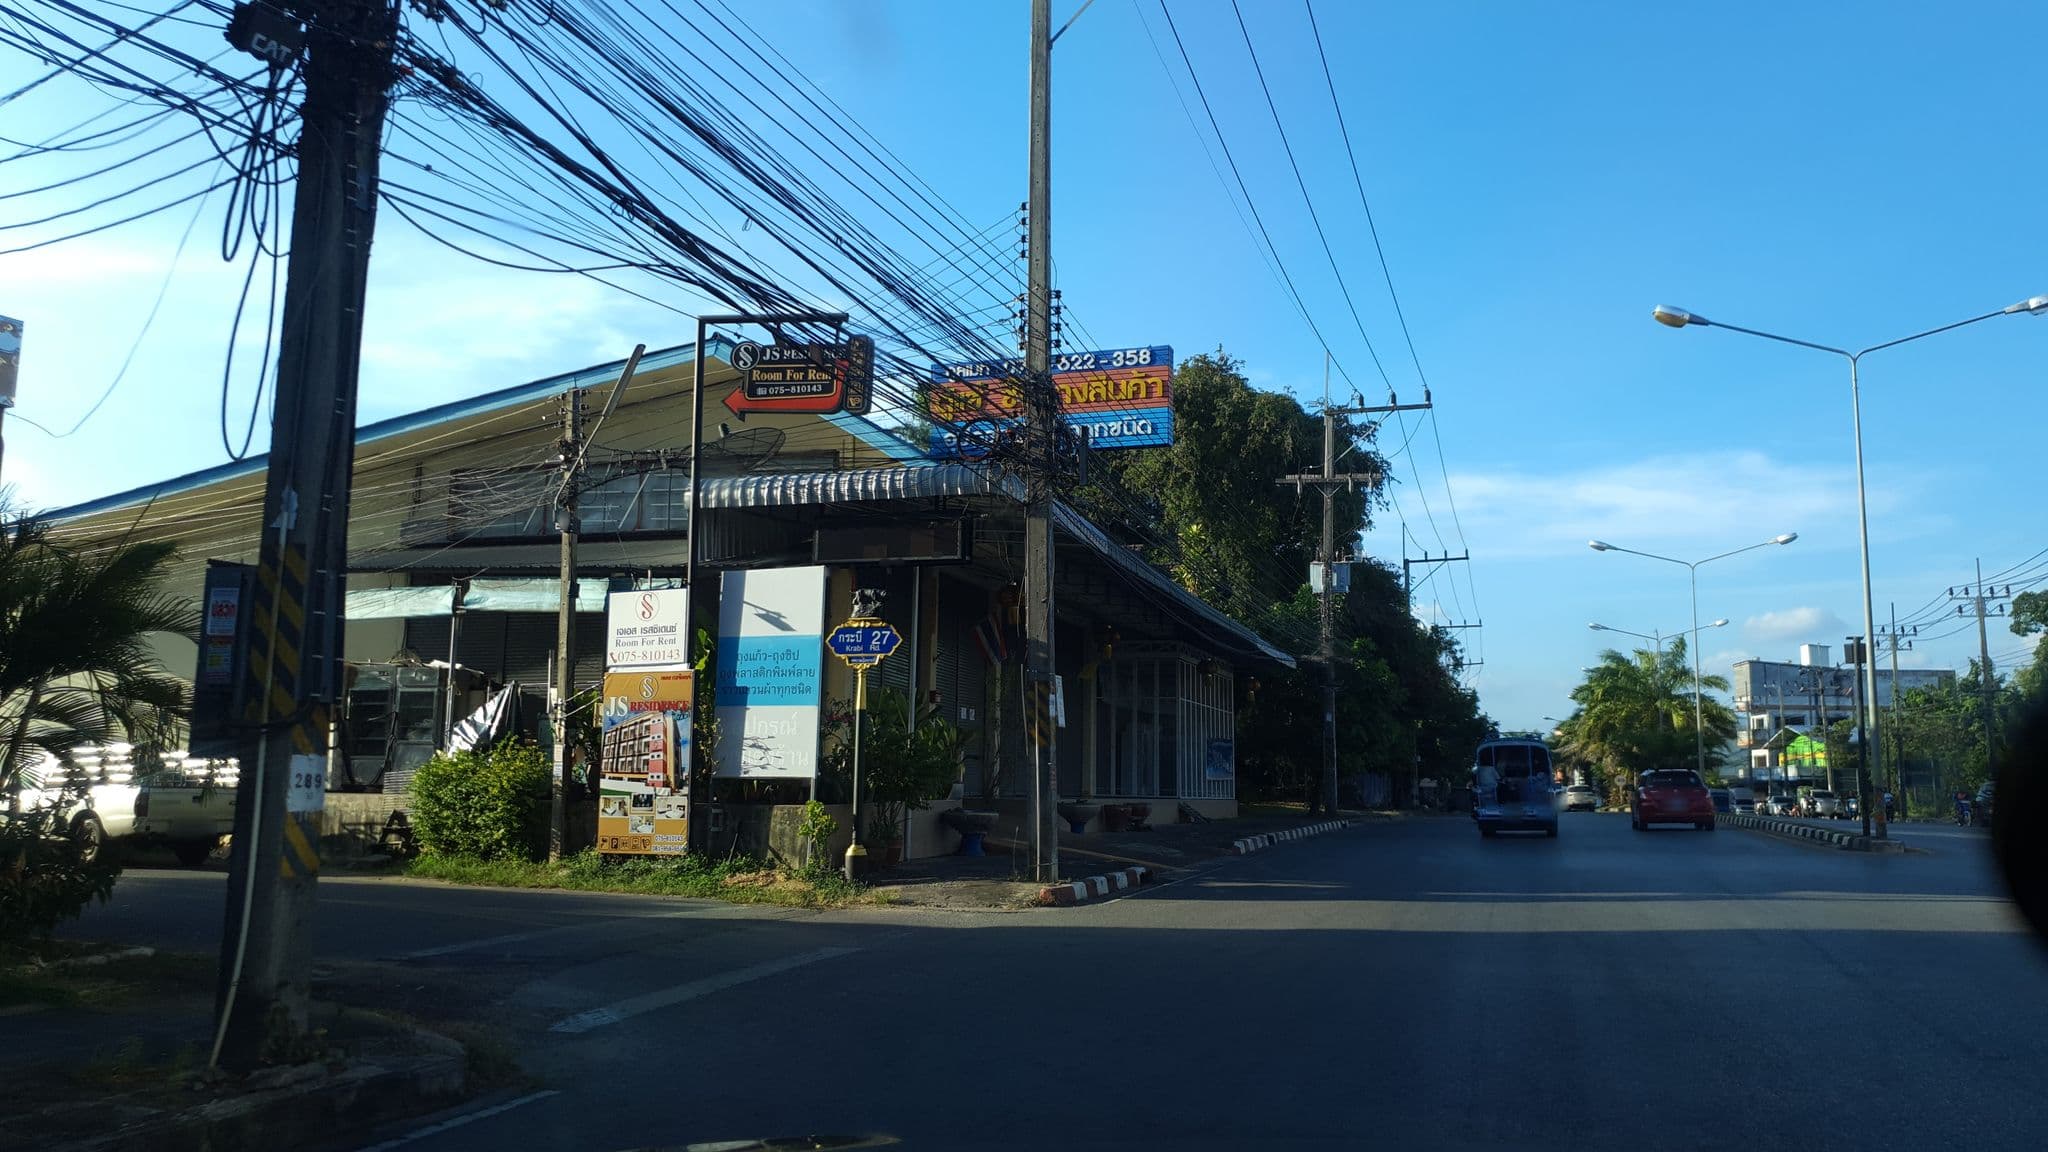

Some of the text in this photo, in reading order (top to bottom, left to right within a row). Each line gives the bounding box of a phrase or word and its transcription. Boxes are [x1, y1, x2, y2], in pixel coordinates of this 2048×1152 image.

[252, 33, 292, 61] CAT
[763, 347, 780, 361] JS
[752, 370, 783, 381] Room
[786, 369, 805, 380] For
[768, 384, 822, 395] 075-810143
[615, 636, 677, 648] Room For Rent
[871, 630, 891, 645] 27
[617, 648, 681, 662] 075-810143
[606, 696, 690, 718] JS RESIDENCE
[295, 772, 322, 789] 289
